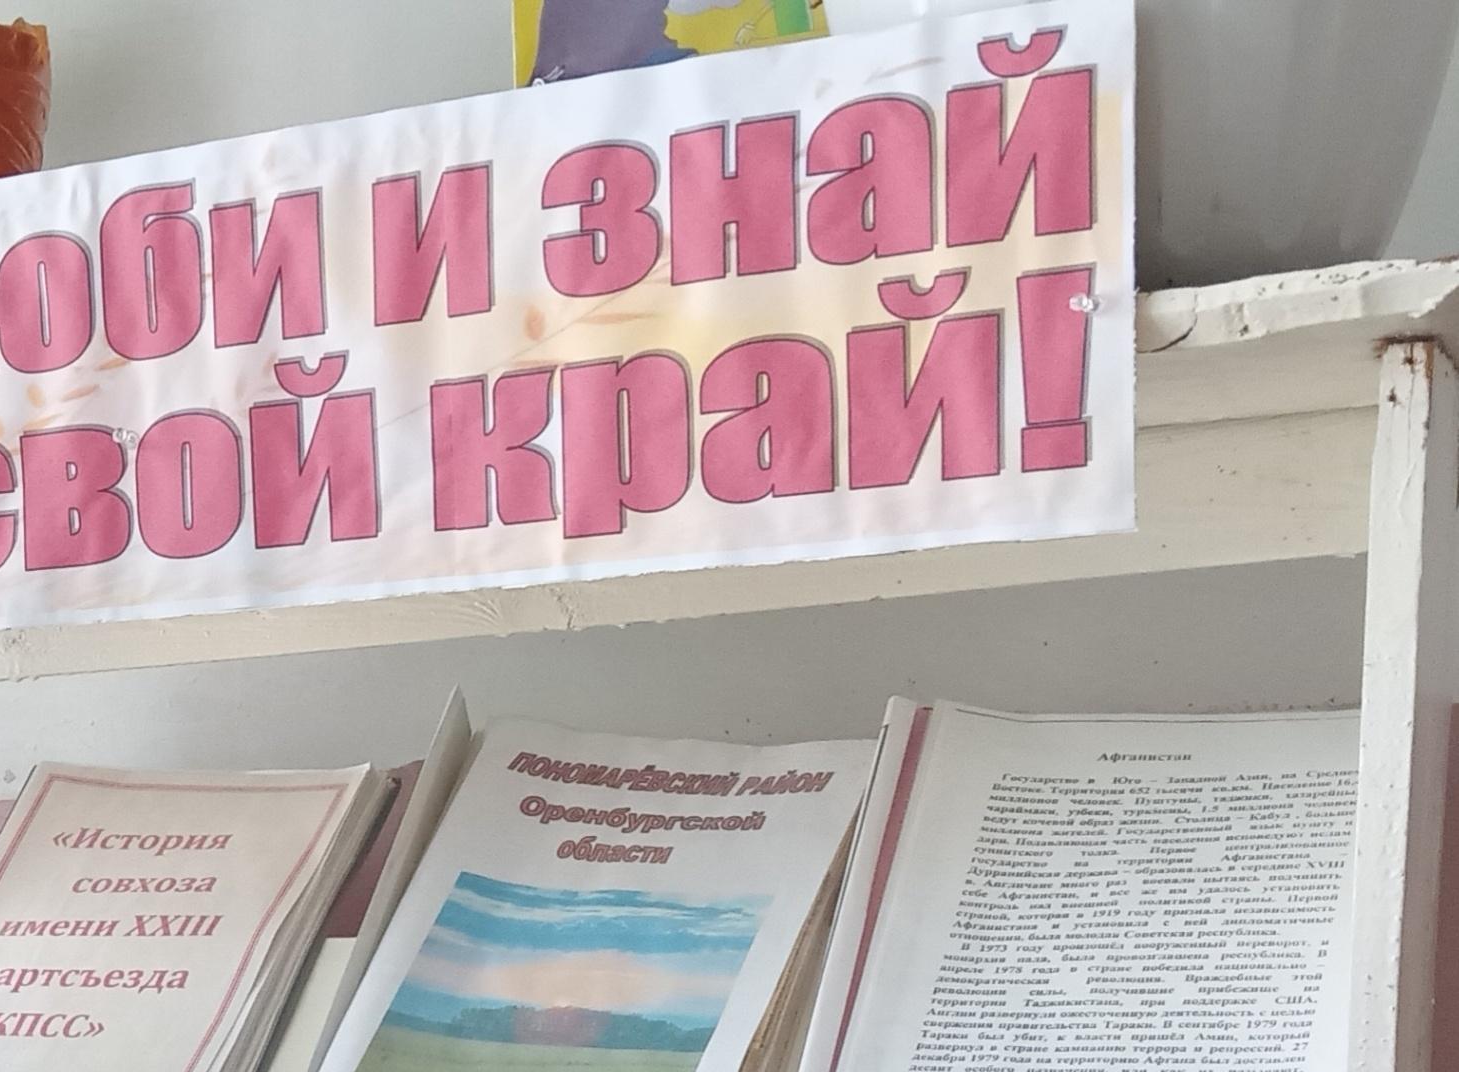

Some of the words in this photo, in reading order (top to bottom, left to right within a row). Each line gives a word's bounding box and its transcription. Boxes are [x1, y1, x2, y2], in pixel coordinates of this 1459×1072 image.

[372, 159, 493, 327] и
[540, 27, 1101, 297] знай
[430, 265, 1094, 539] край!
[1097, 751, 1192, 762] Афганистан
[507, 752, 738, 796] ПОНОМАРЁВСКИЙ
[737, 770, 834, 796] РАЙОН
[519, 796, 766, 833] Оренбургской
[51, 827, 233, 856] «История
[557, 837, 674, 864] области
[71, 875, 217, 894] совхоза
[123, 914, 223, 937] XXIII
